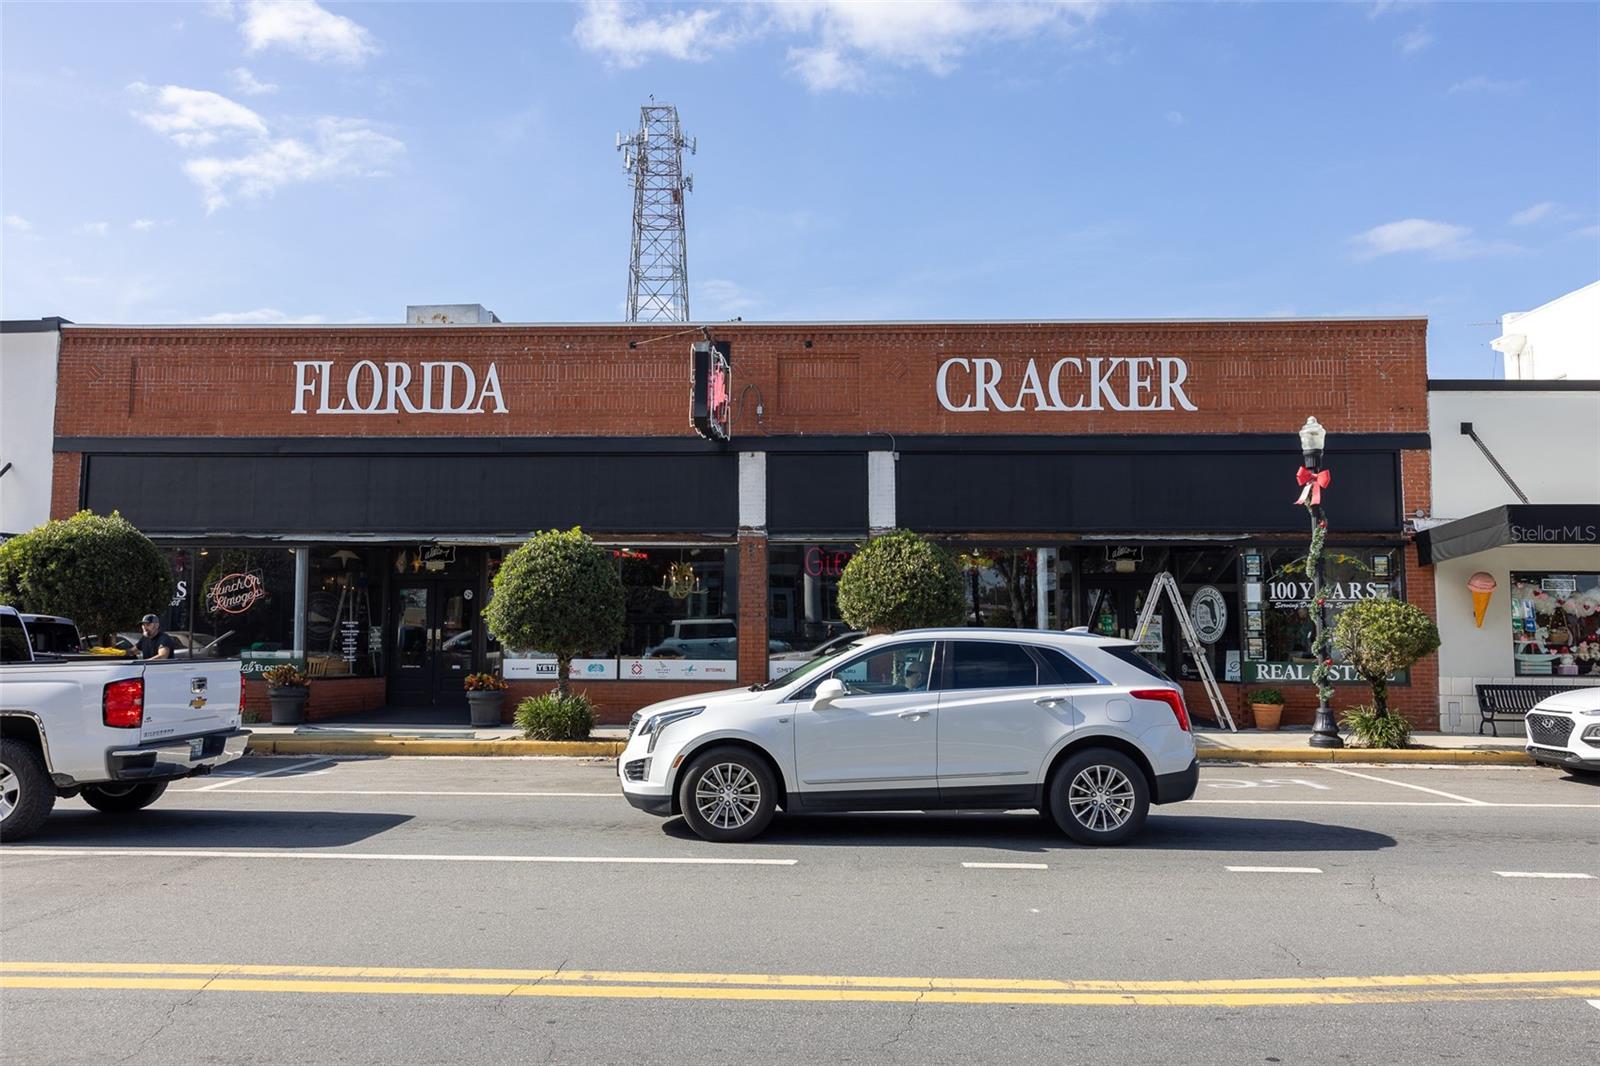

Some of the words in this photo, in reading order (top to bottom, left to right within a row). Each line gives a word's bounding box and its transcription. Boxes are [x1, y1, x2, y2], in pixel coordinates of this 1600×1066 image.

[291, 359, 509, 414] FLORIDA
[935, 357, 1198, 412] CRACKER
[1269, 582, 1297, 600] 100
[1299, 582, 1377, 600] YARS
[1256, 664, 1310, 680] REAL
